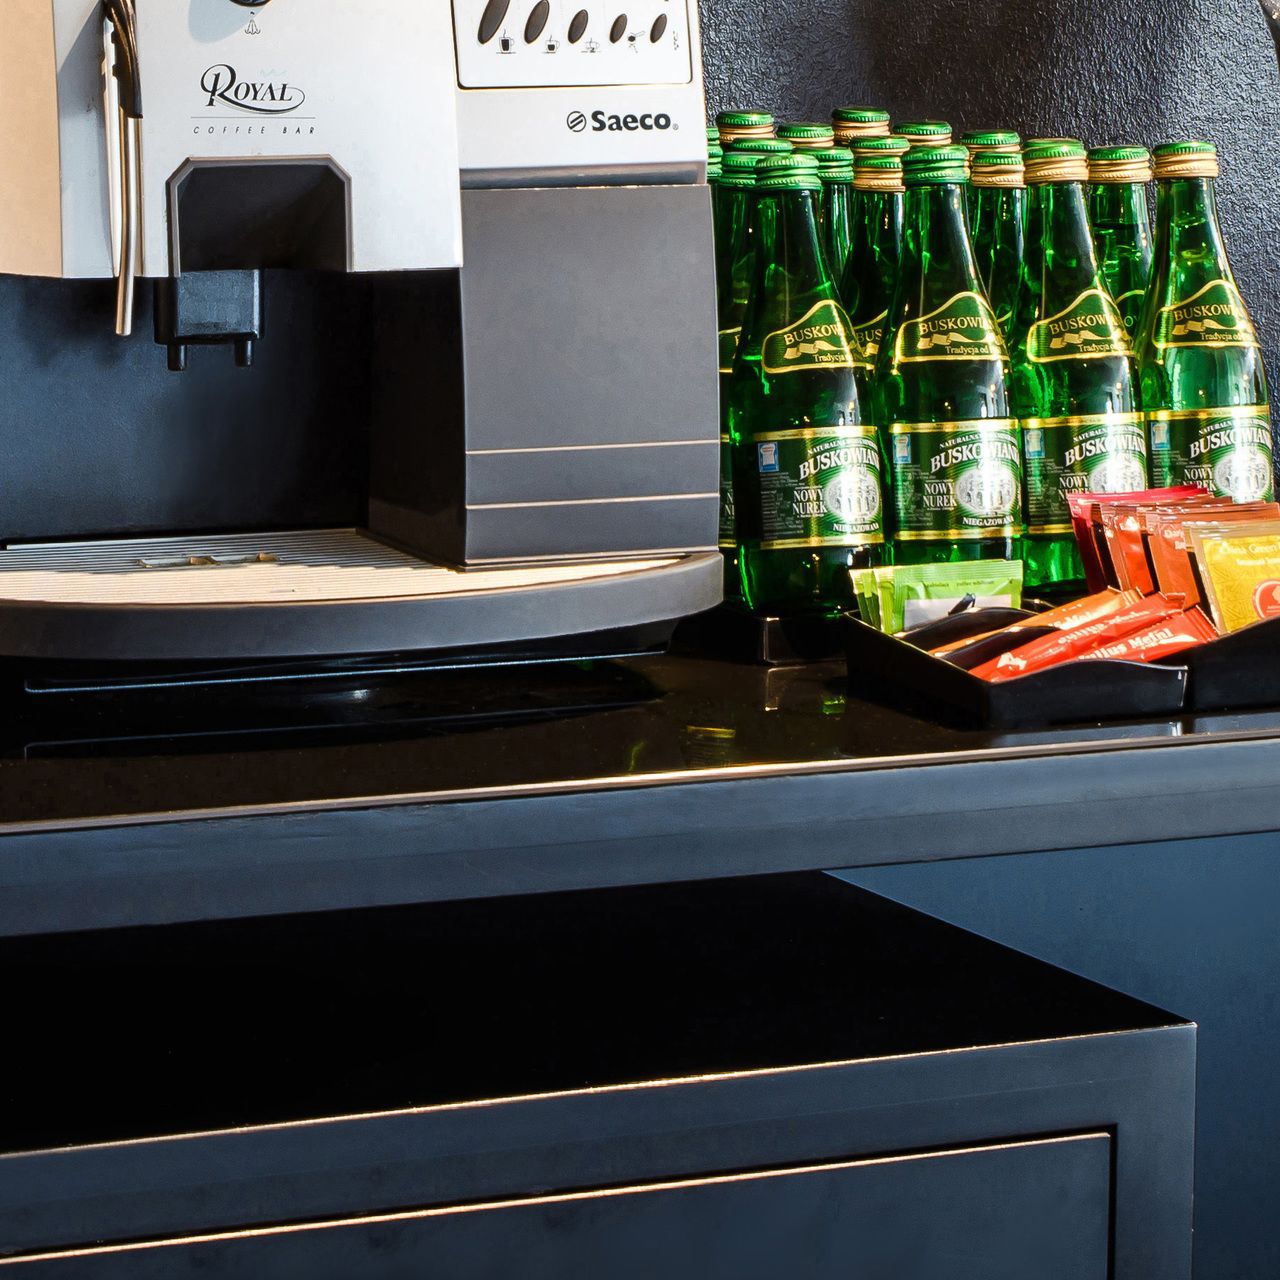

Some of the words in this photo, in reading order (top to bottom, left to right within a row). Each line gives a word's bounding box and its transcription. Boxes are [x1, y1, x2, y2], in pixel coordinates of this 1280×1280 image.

[591, 110, 671, 131] Saeco
[193, 126, 265, 135] COFFEE
[282, 126, 315, 135] BAR
[1184, 467, 1214, 480] NOWY
[924, 482, 955, 495] NOWY
[1059, 475, 1089, 489] NOWY
[793, 488, 824, 502] NOWY
[922, 495, 957, 508] NUREK
[792, 501, 828, 515] NUREK
